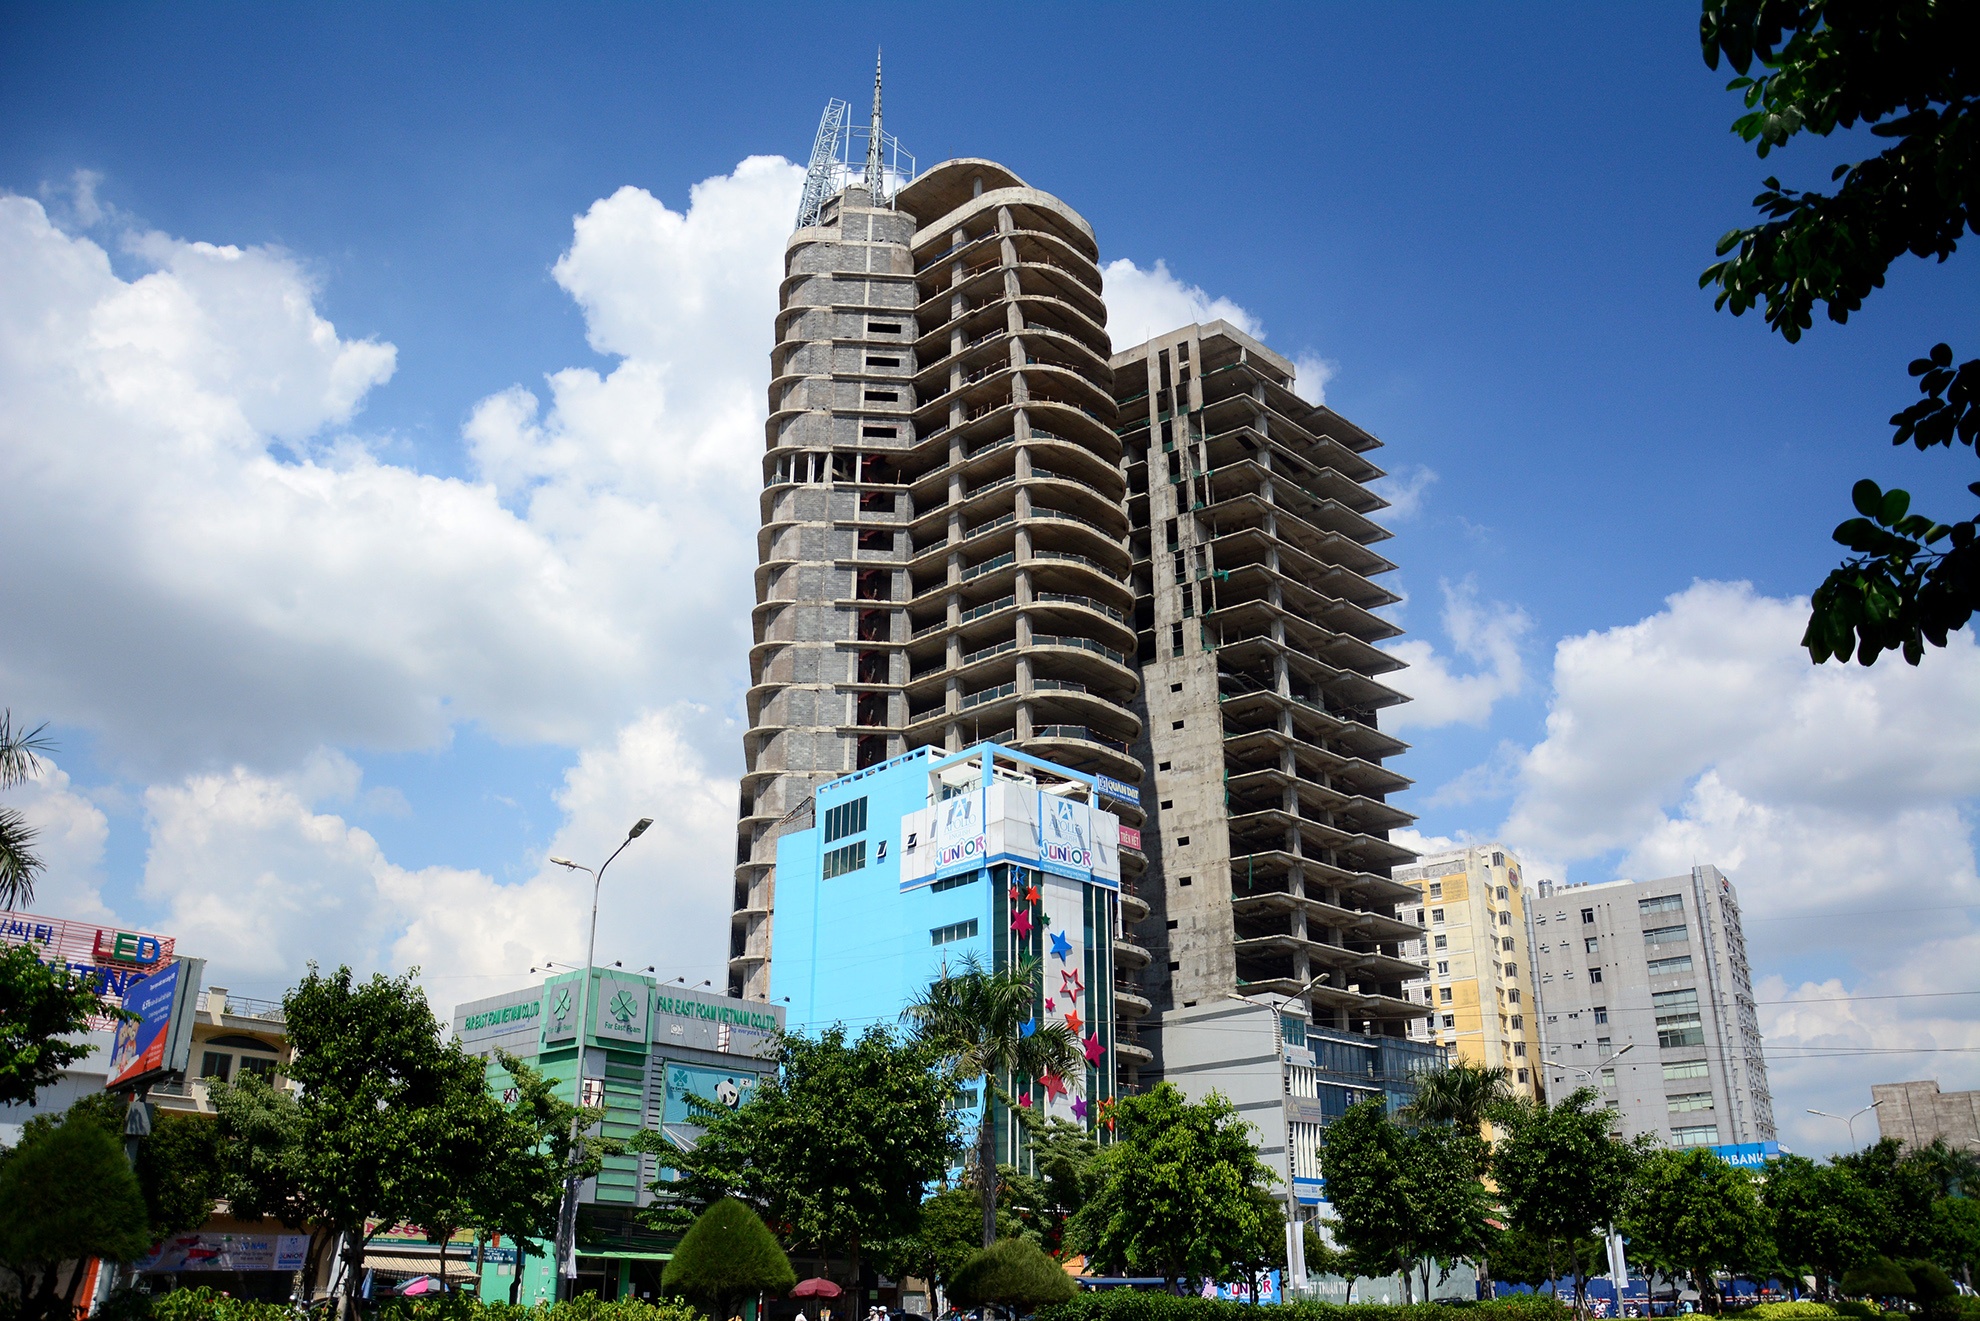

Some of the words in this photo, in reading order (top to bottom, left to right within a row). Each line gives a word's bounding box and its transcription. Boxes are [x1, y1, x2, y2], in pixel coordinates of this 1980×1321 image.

[944, 813, 977, 832] APOLLO
[1049, 819, 1083, 836] APOLLO
[92, 929, 161, 964] LED
[657, 995, 673, 1013] FAR
[674, 998, 695, 1017] EAST
[695, 1001, 717, 1022] FOAM
[717, 1005, 750, 1027] VIETNAM
[604, 1021, 614, 1029] Far
[614, 1023, 626, 1032] East
[626, 1024, 641, 1034] Foam
